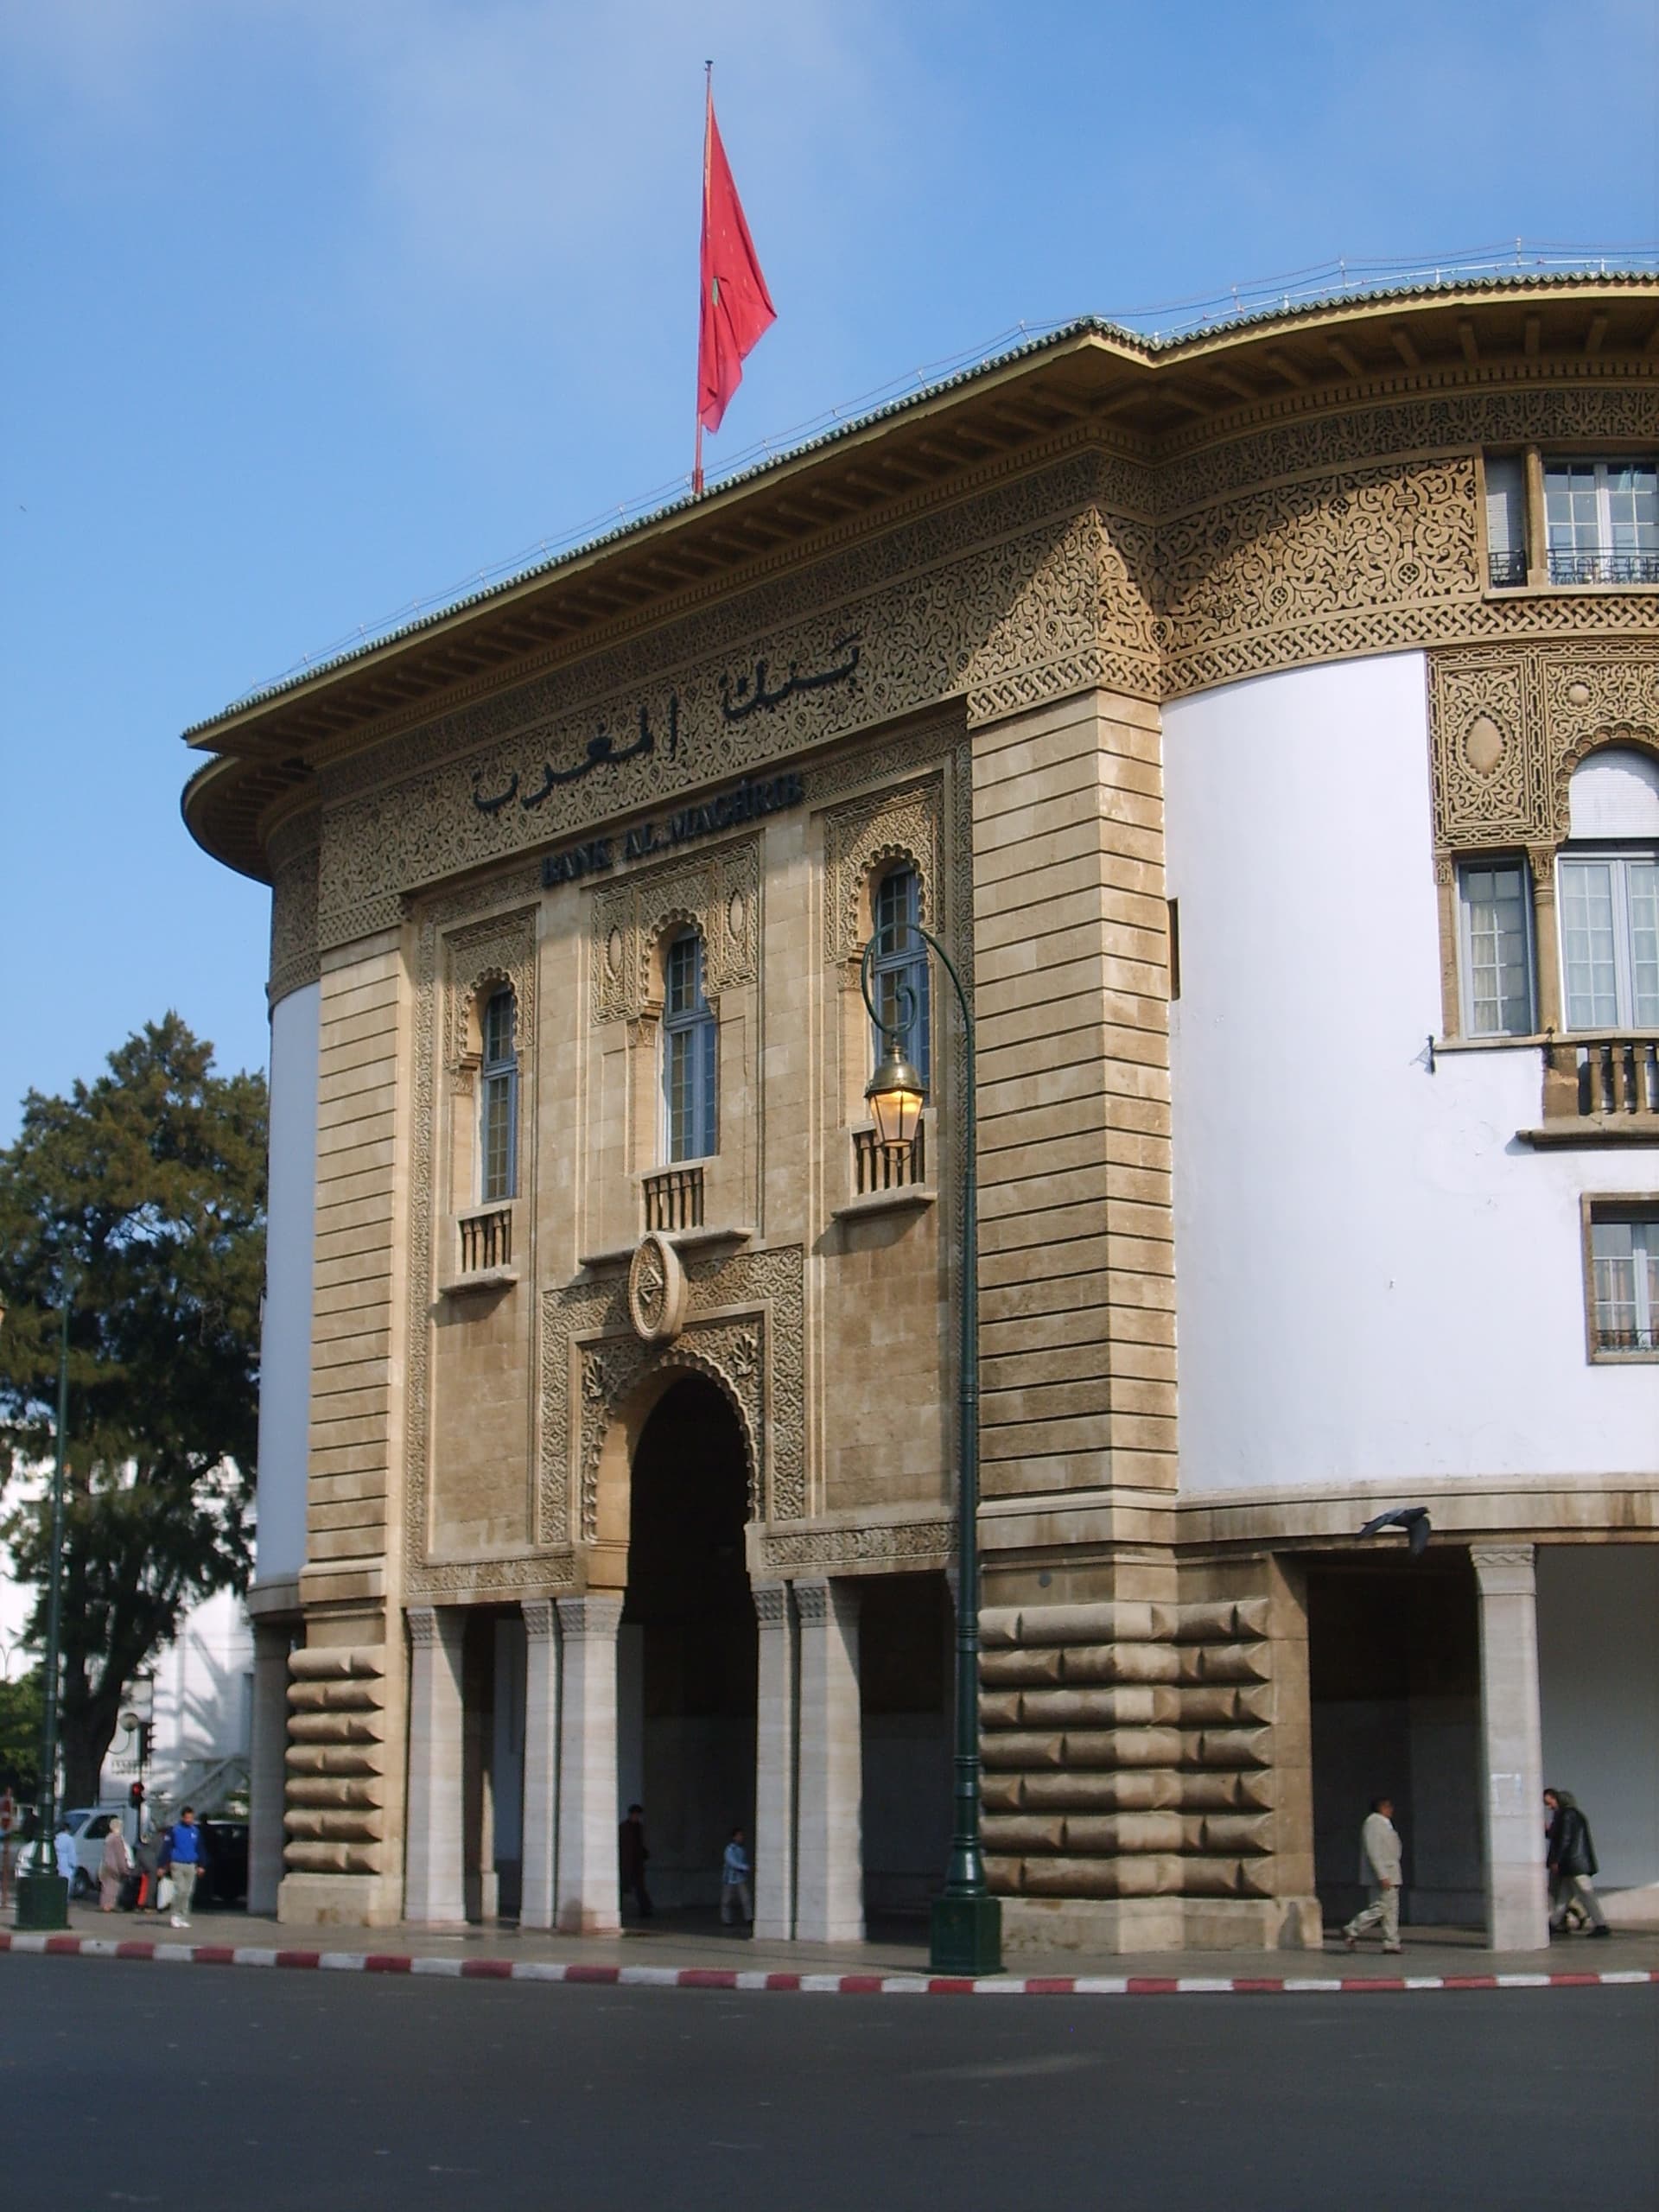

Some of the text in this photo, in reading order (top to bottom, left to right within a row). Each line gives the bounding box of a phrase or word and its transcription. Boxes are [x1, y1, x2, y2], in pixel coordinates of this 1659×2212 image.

[473, 692, 678, 813] المغرب
[541, 837, 614, 888] BANK
[669, 773, 803, 843] MAGHRIB
